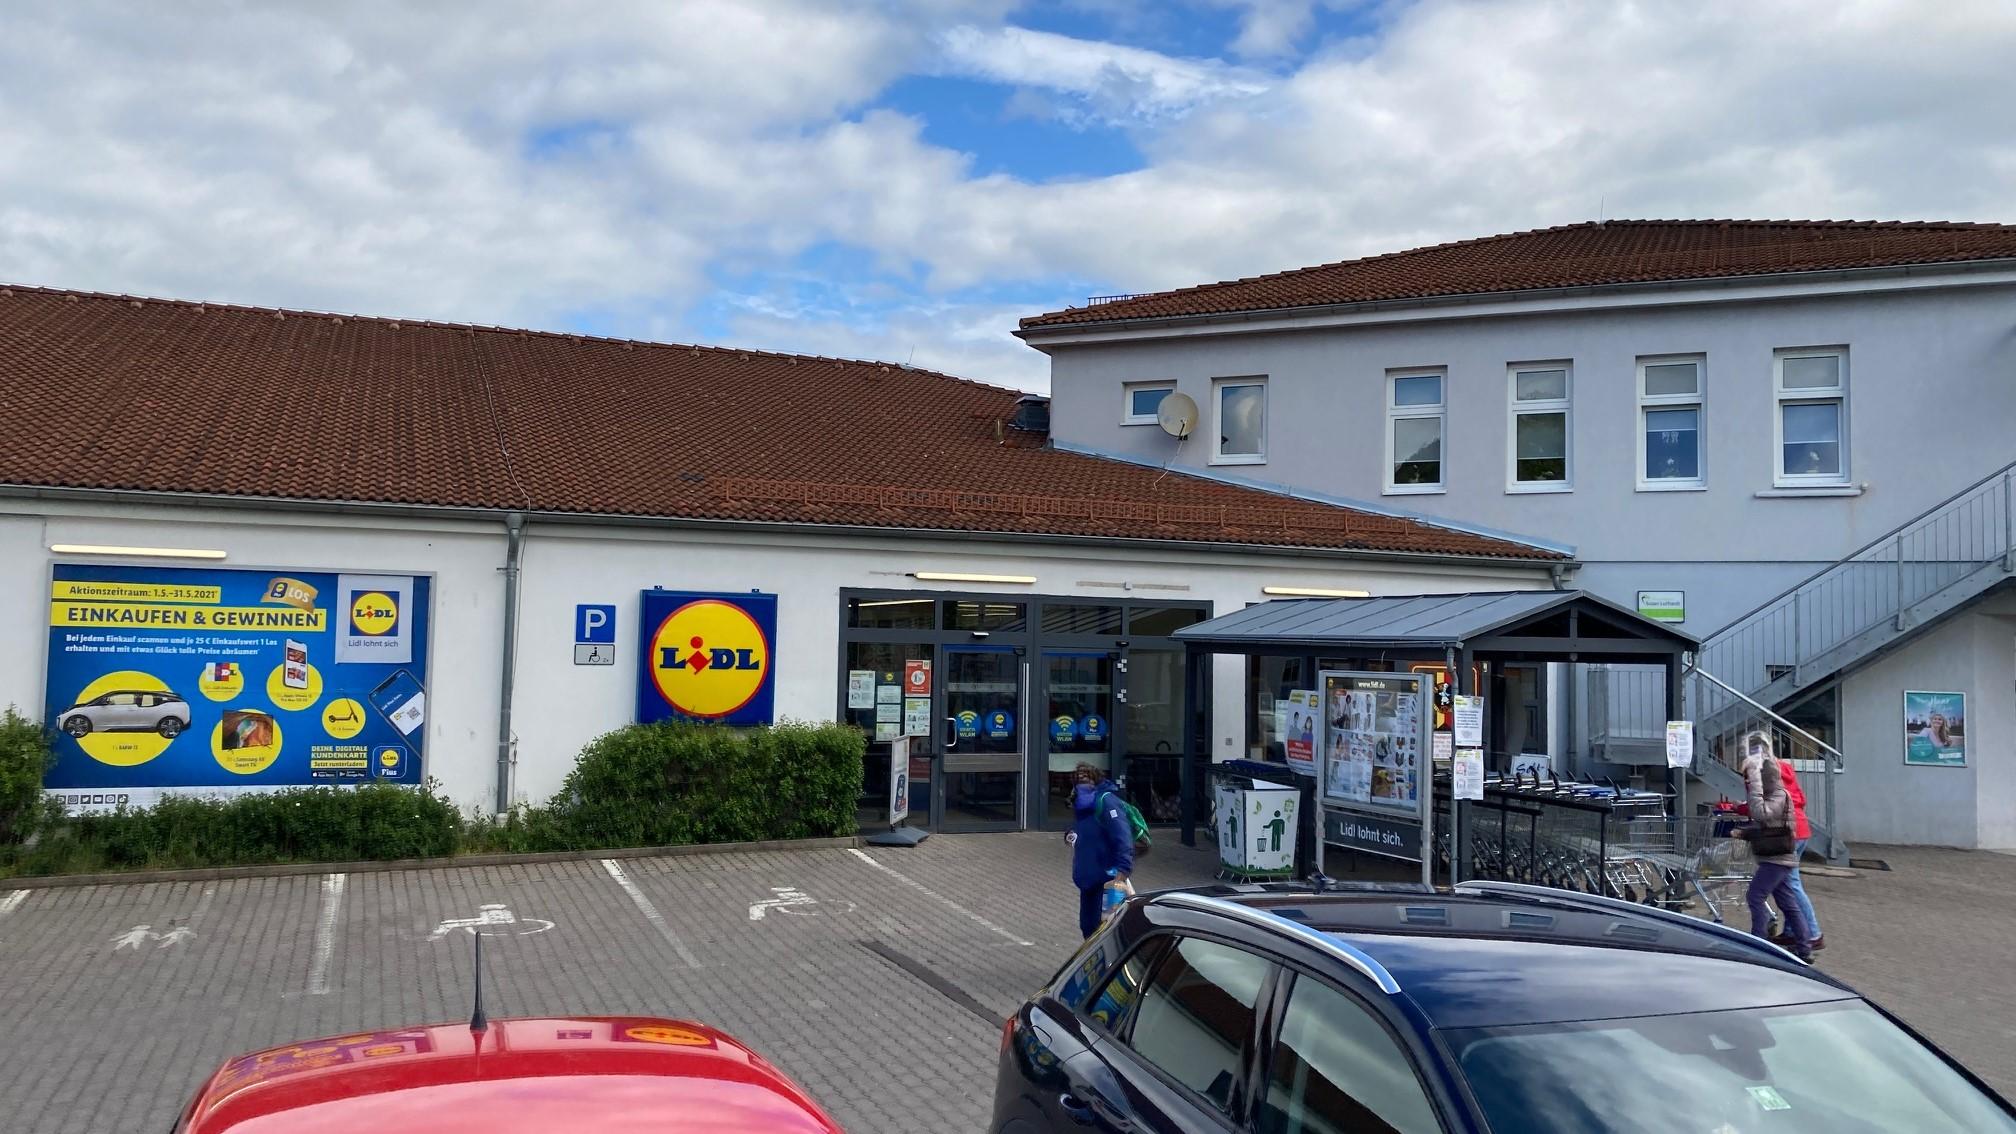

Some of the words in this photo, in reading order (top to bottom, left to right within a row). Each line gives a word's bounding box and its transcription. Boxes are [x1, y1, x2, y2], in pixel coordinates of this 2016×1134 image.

[69, 586, 151, 597] Aktionszeitraum:
[288, 587, 310, 603] LOS
[68, 607, 187, 624] EINKAUFEN
[193, 611, 206, 625] &
[355, 605, 394, 619] LIDL
[585, 609, 606, 638] P
[66, 634, 79, 642] Bei
[80, 635, 104, 644] jedem
[106, 635, 136, 643] Einkauf
[195, 637, 204, 645] 25
[212, 638, 259, 646] Einkaufswert
[99, 645, 115, 653] und
[155, 646, 178, 654] Glück
[197, 647, 221, 655] Preise
[660, 636, 760, 675] LIDL
[1340, 822, 1356, 837] Lidl
[1358, 825, 1380, 842] lohnt
[1382, 830, 1404, 847] sich.
